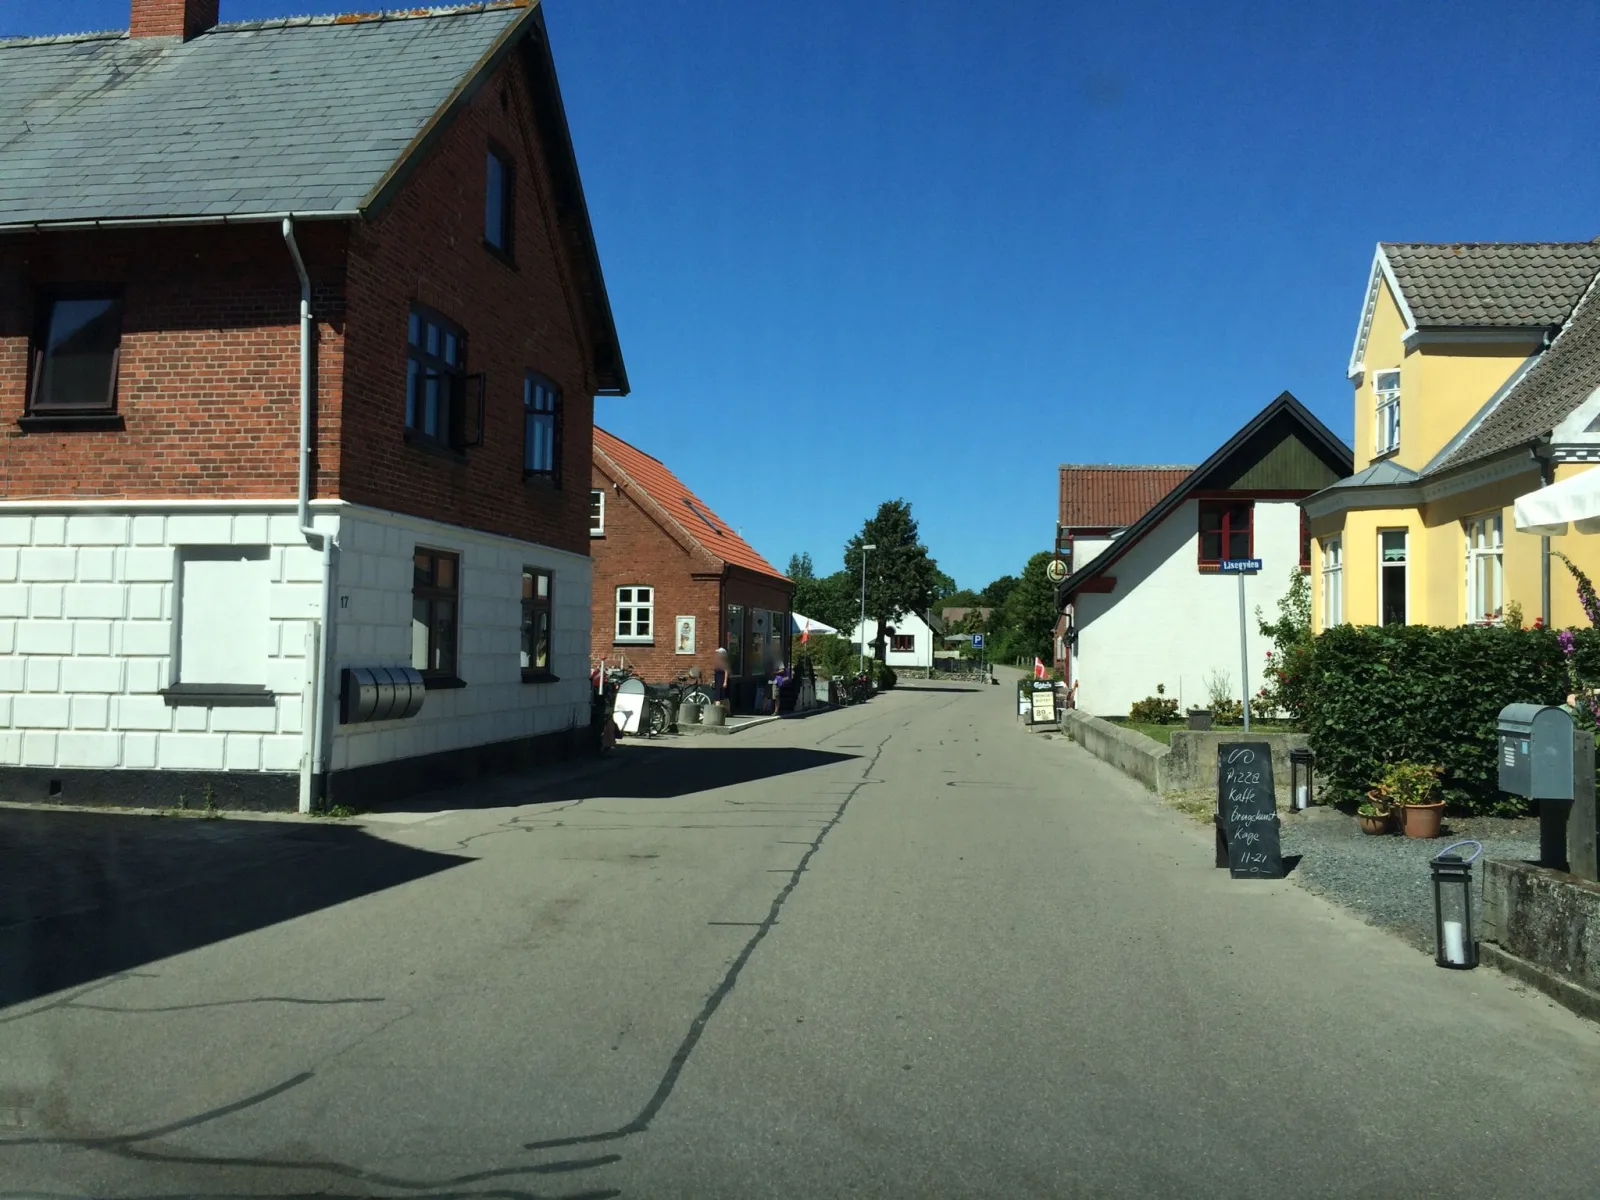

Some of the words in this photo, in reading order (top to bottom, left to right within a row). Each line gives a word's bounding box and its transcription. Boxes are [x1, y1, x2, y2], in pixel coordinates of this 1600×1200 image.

[1223, 560, 1259, 570] Lisegyden
[340, 595, 349, 608] 17
[974, 635, 981, 643] P
[1228, 787, 1256, 803] Kaffe
[1234, 827, 1260, 845] Kage
[1240, 852, 1268, 863] 11-21
